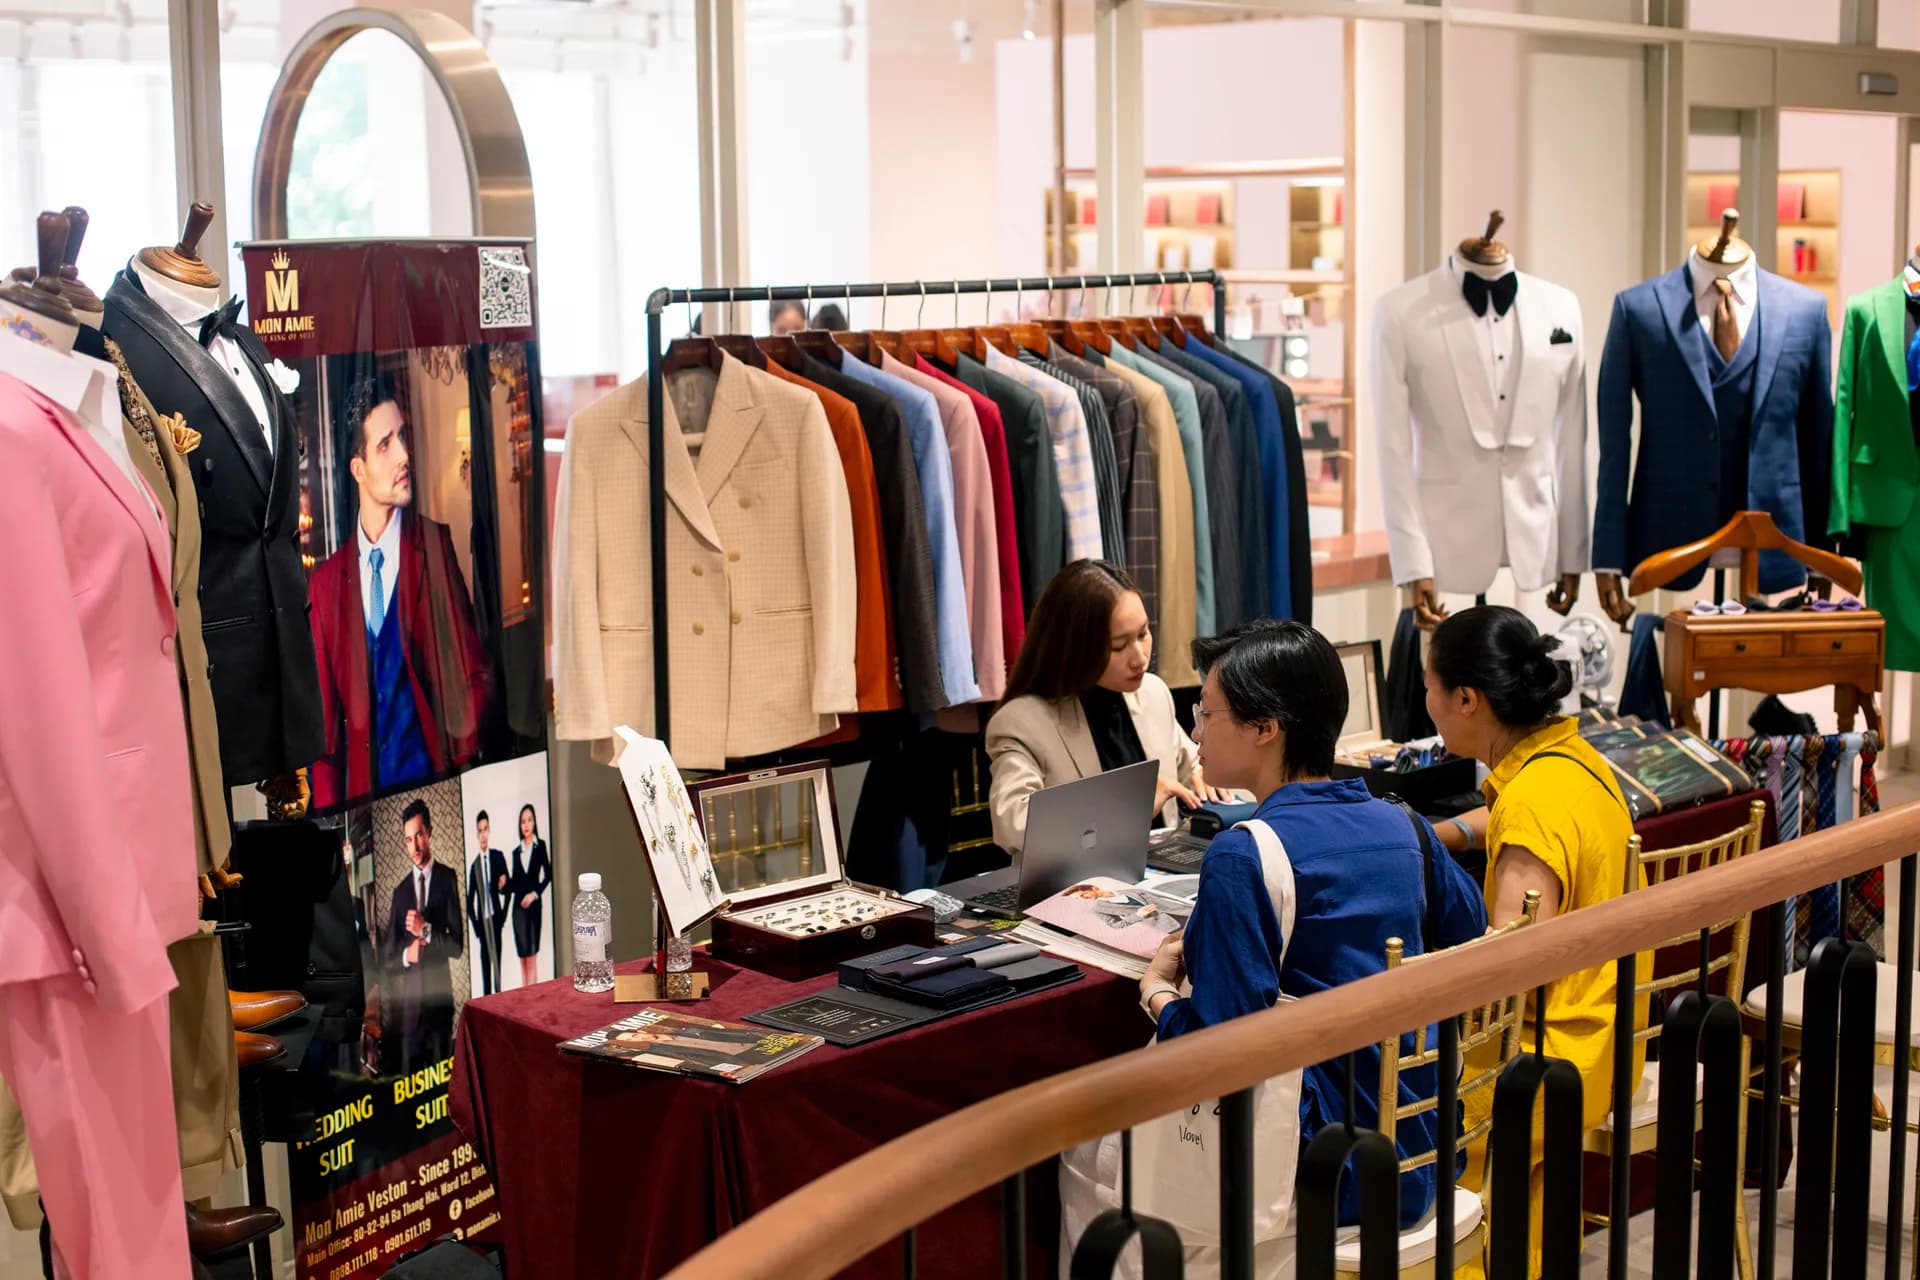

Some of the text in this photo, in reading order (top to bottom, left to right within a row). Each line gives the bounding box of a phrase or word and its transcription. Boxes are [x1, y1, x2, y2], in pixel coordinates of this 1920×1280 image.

[254, 315, 315, 334] MON AMIE
[610, 1011, 662, 1030] AMIE
[296, 1094, 373, 1149] EDDING
[416, 1093, 449, 1129] SUIT
[320, 1138, 355, 1176] SUIT
[305, 1219, 333, 1246] Mon
[335, 1200, 365, 1230] Amie
[367, 1180, 408, 1212] Veston
[419, 1158, 450, 1186] Since
[307, 1249, 327, 1268] Main
[328, 1236, 353, 1256] Office:
[354, 1212, 390, 1242] 80-82-84
[391, 1208, 402, 1223] Ba
[402, 1196, 424, 1218] Thang
[440, 1176, 459, 1196] Ward
[384, 1217, 431, 1254] 0901.611.119
